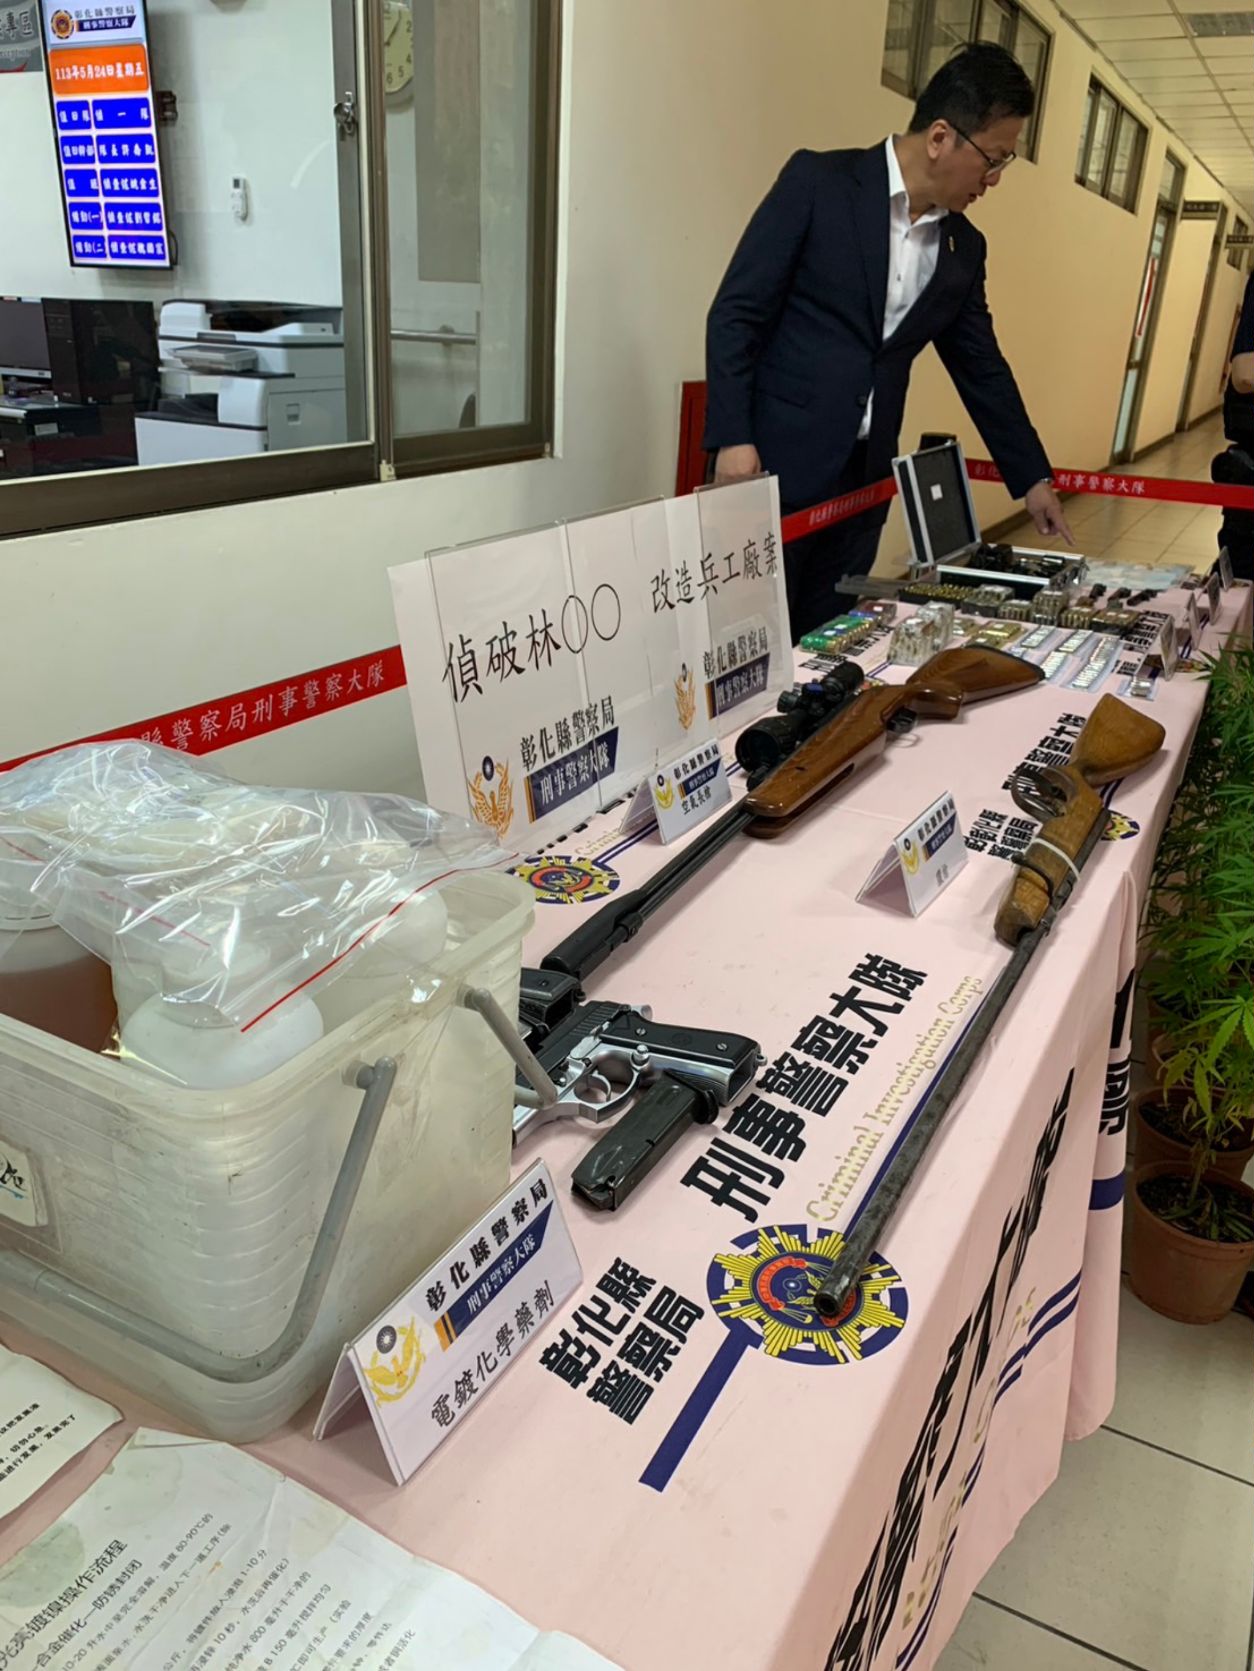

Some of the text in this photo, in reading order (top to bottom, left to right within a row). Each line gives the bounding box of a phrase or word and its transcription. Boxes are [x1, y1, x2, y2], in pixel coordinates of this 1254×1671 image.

[55, 62, 145, 80] 113年5月24日星期五
[650, 531, 778, 614] 改造兵工廠案
[702, 626, 768, 680] 彰化縣警察局
[520, 695, 615, 772] 彰化縣警察局
[540, 741, 610, 805] 刑事警察大隊
[679, 953, 928, 1223] 刑事警察大隊
[806, 1124, 883, 1222] Criminal
[862, 1013, 955, 1127] Investigation
[426, 1178, 548, 1313] 彰化縣警察局
[466, 1233, 536, 1315] 刑事警察大隊
[431, 1280, 554, 1428] 電鍍化學藥劑
[538, 1256, 657, 1389] 彰化縣
[586, 1285, 705, 1425] 警察局
